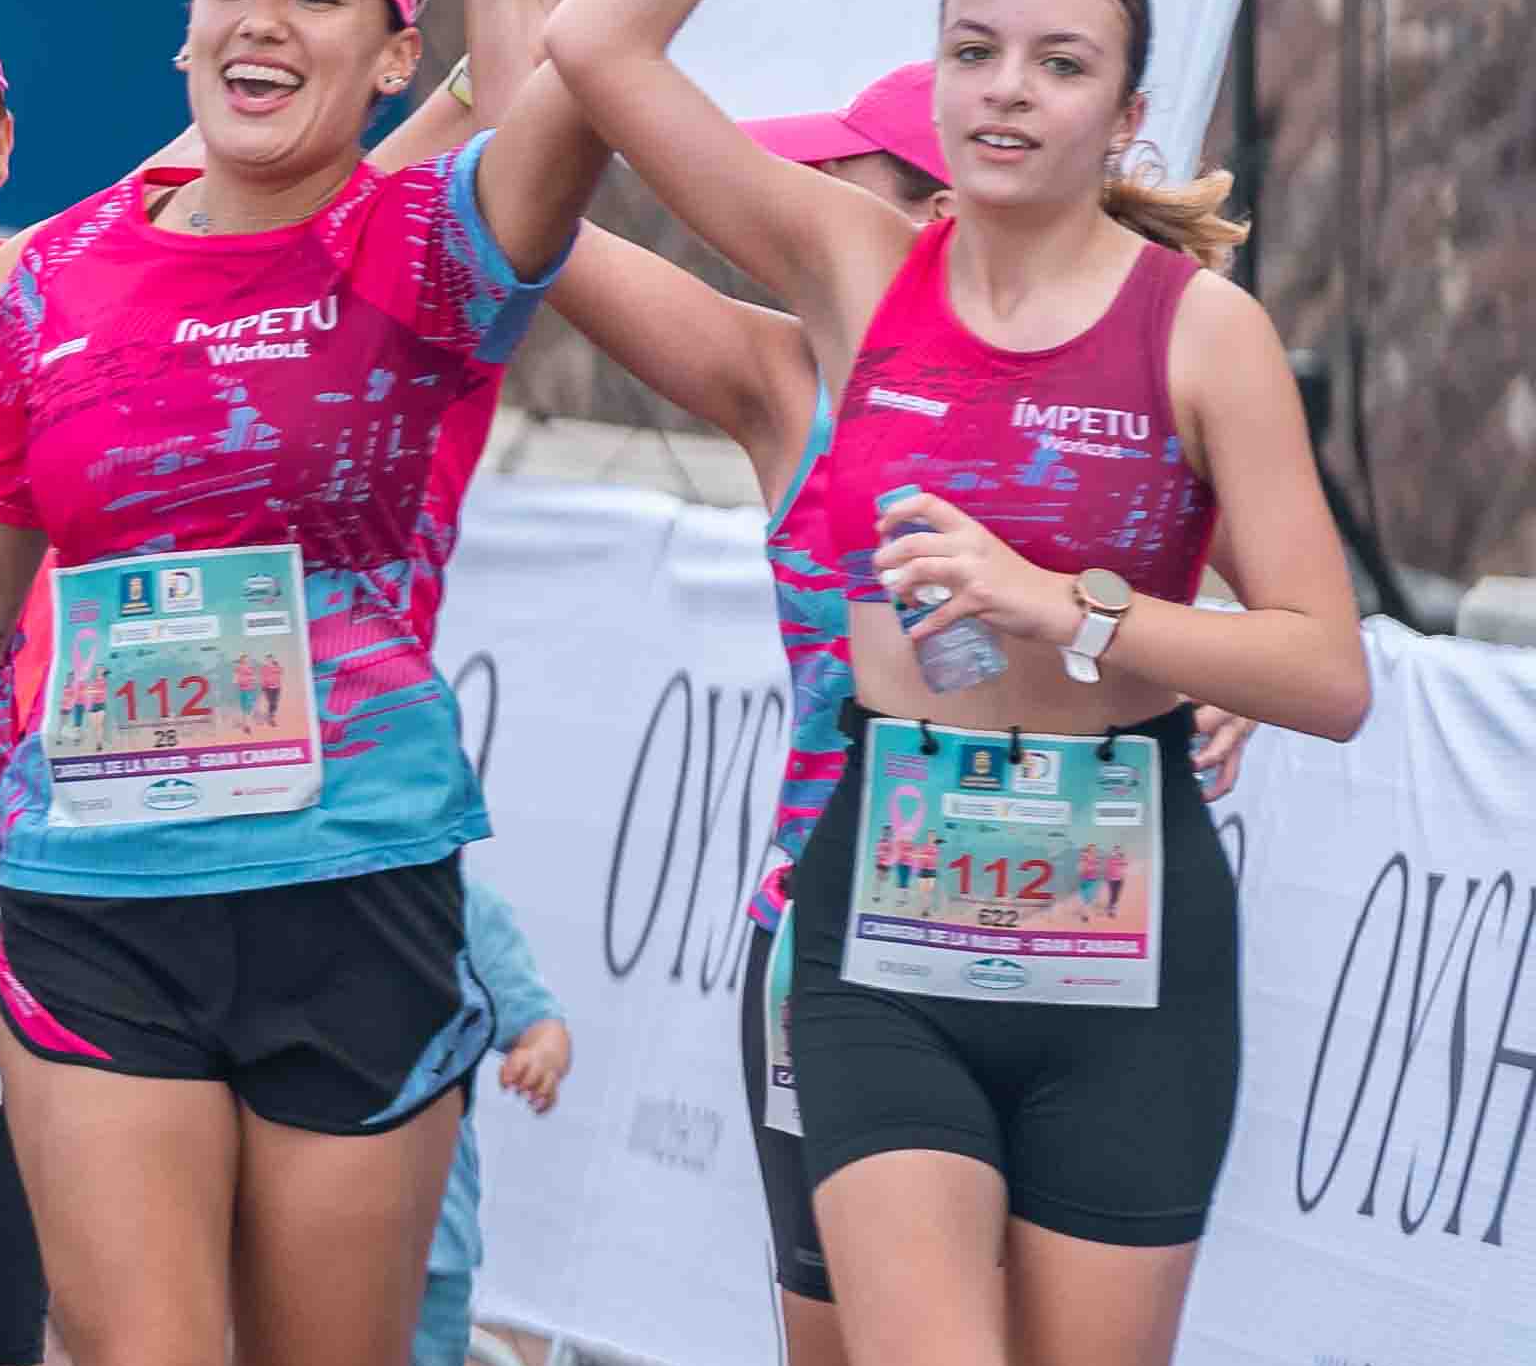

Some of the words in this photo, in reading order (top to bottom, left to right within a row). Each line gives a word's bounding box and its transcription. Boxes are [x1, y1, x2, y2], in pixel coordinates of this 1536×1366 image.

[1011, 396, 1151, 441] ÍMPETU
[115, 675, 213, 721] 112
[153, 729, 177, 748] 28
[604, 668, 785, 998] OYS
[948, 852, 1057, 900] 112
[978, 909, 1019, 928] 622
[1296, 851, 1536, 1247] OYSH
